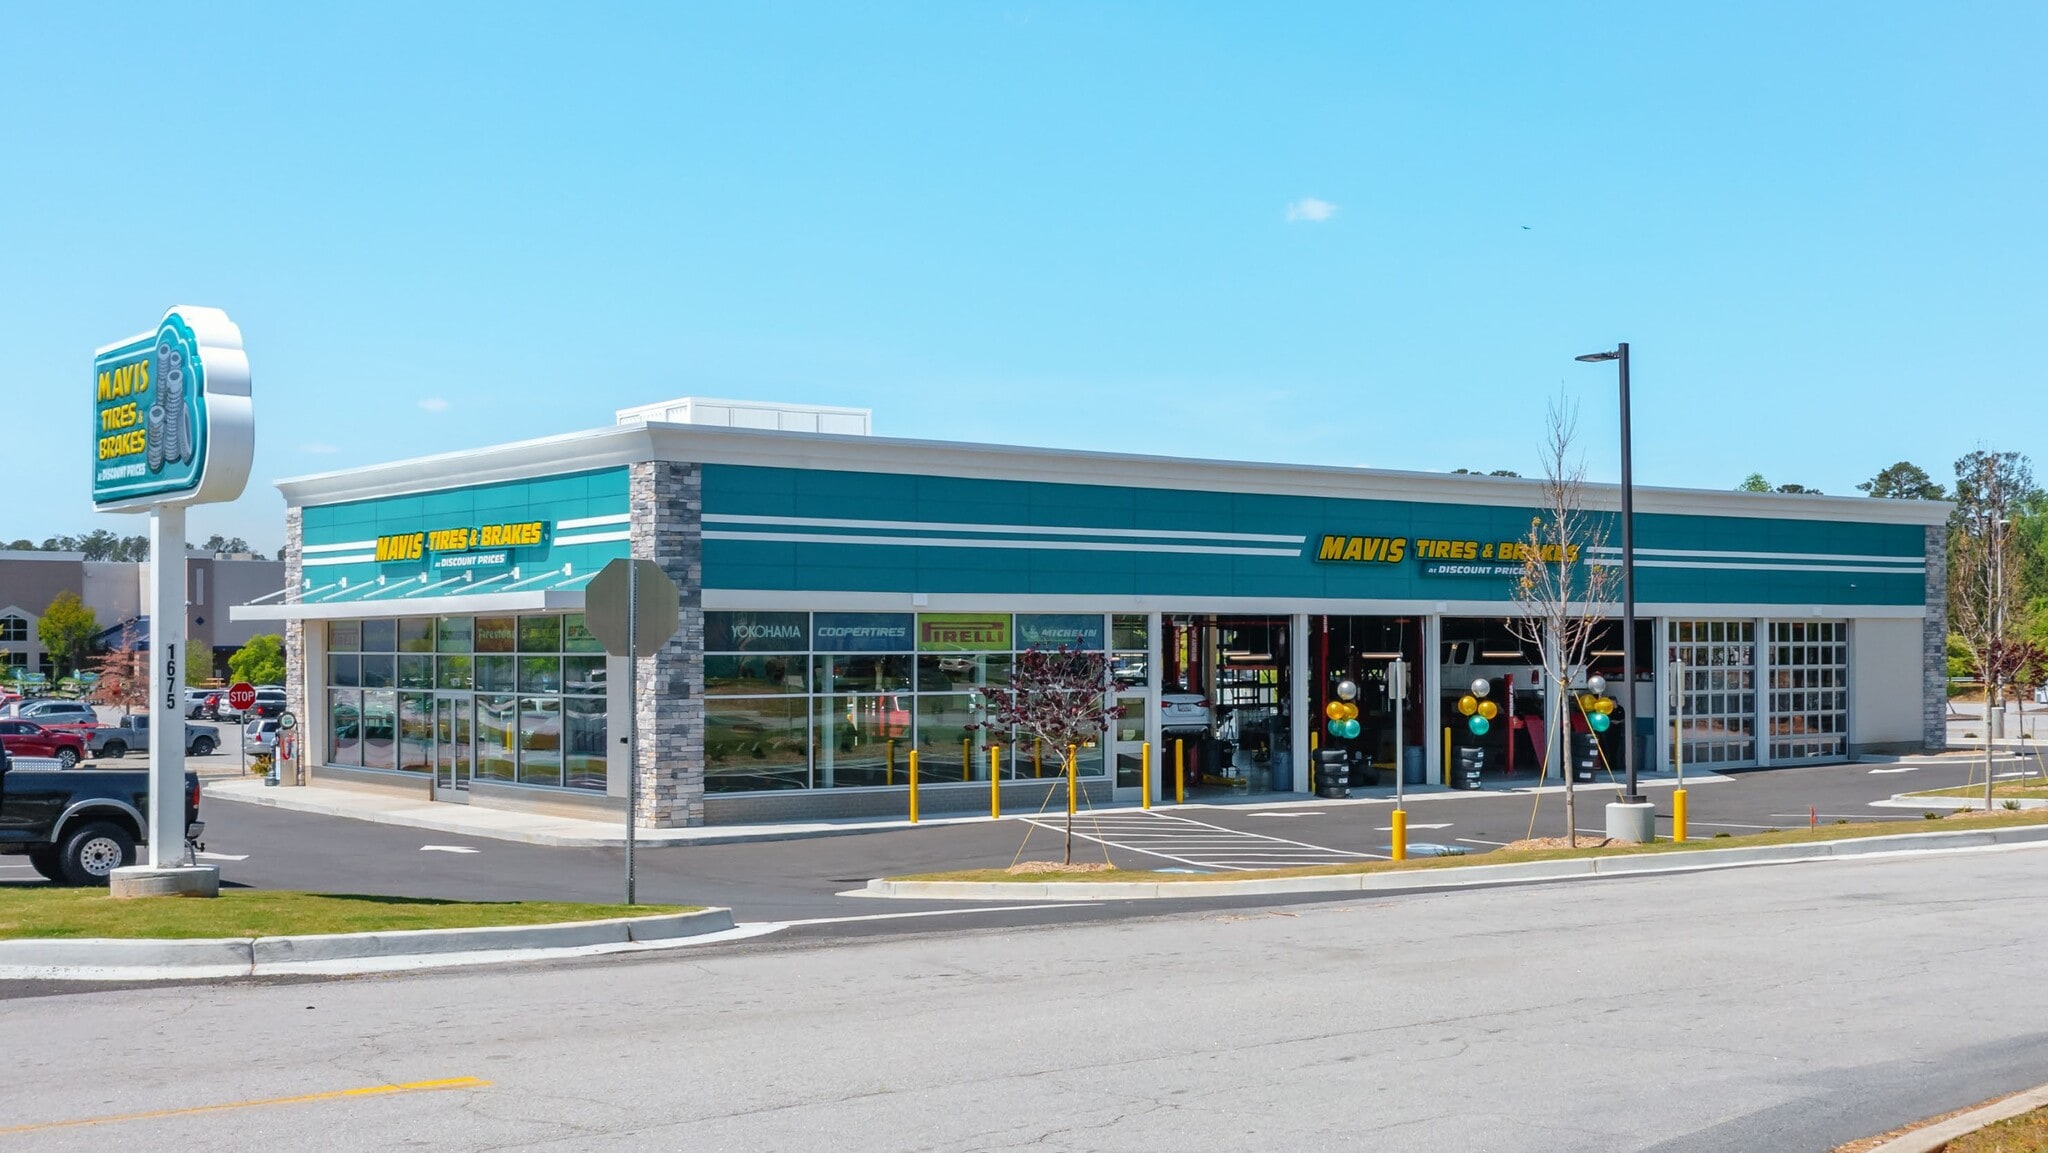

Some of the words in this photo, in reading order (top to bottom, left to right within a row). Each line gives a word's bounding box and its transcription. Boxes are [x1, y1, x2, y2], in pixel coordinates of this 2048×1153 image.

[97, 360, 148, 403] MAVIS
[101, 403, 137, 430] TIRES
[138, 410, 143, 424] &
[99, 430, 145, 460] BRAKES
[102, 466, 126, 480] DISCOUNT
[127, 463, 146, 477] PRICES
[375, 532, 424, 562] MAVIS
[429, 527, 469, 551] TIRES
[470, 528, 478, 547] &
[481, 522, 542, 546] BRAKES
[1319, 535, 1407, 563] MAVIS
[1416, 539, 1479, 560] TIRES
[1481, 543, 1493, 559] &
[441, 555, 477, 568] DISCOUNT
[477, 554, 506, 565] PRICES
[1438, 565, 1492, 575] DISCOUNT
[731, 624, 801, 639] YOKOHAMA
[922, 621, 1005, 643] PIRELLI
[1042, 629, 1097, 637] MICHELIN
[230, 691, 255, 702] STOP
